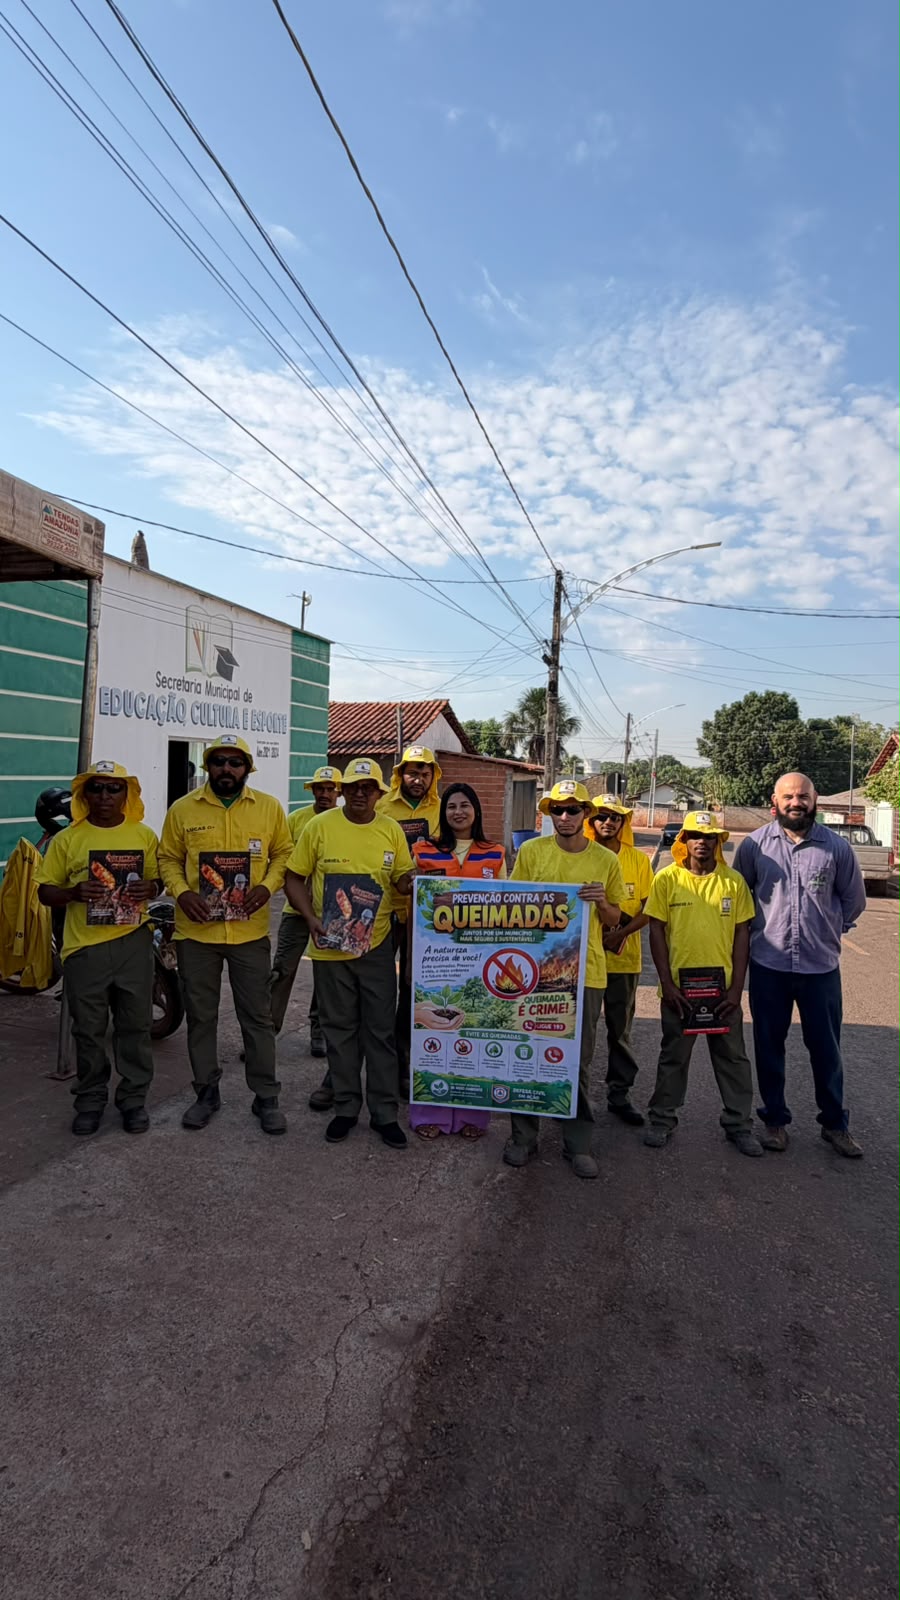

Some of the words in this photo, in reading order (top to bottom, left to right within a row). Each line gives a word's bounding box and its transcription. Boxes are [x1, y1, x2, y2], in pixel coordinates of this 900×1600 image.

[53, 508, 80, 528] TENDAS
[155, 670, 202, 696] Secretaria
[204, 680, 240, 703] Municipal
[243, 688, 253, 703] de
[190, 701, 240, 730] CULTURA
[242, 708, 249, 731] E
[251, 709, 288, 735] ESPORTE
[186, 825, 206, 833] LUCAS
[452, 892, 501, 904] PREVENÇÃO
[503, 893, 539, 904] CONTRA
[542, 893, 555, 903] AS
[433, 904, 569, 933] QUEIMADAS
[424, 945, 432, 955] A
[433, 946, 468, 954] natureza
[421, 954, 450, 964] precisa
[462, 952, 482, 962] você!
[523, 994, 566, 1004] QUEIMADA
[518, 1002, 526, 1017] É
[528, 1002, 570, 1016] CRIME!
[465, 1030, 480, 1038] EVITE
